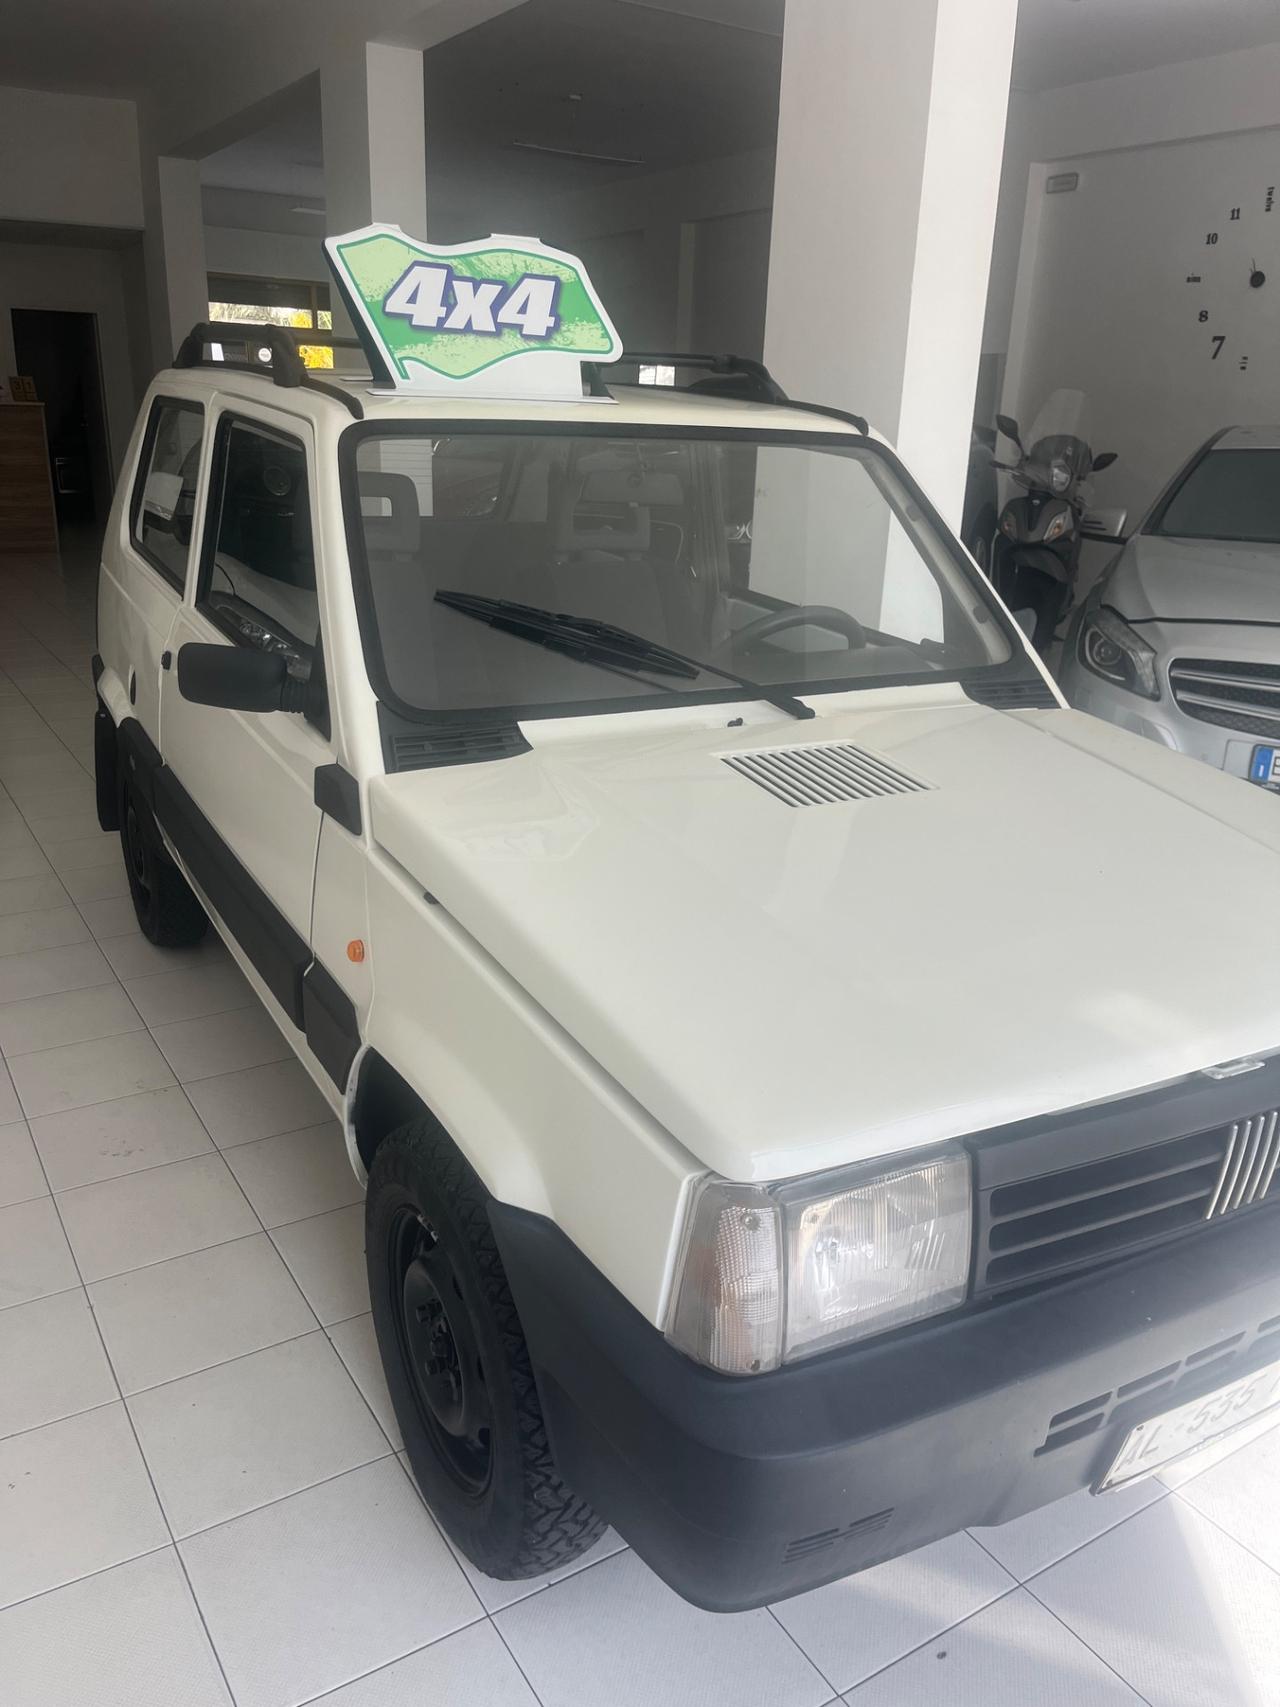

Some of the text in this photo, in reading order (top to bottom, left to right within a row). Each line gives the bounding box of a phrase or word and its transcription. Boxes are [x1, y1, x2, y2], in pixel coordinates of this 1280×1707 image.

[1230, 208, 1240, 220] 11
[1206, 232, 1218, 245] 10
[384, 262, 559, 339] 4x4
[1198, 309, 1209, 323] 8
[1211, 335, 1226, 360] 7
